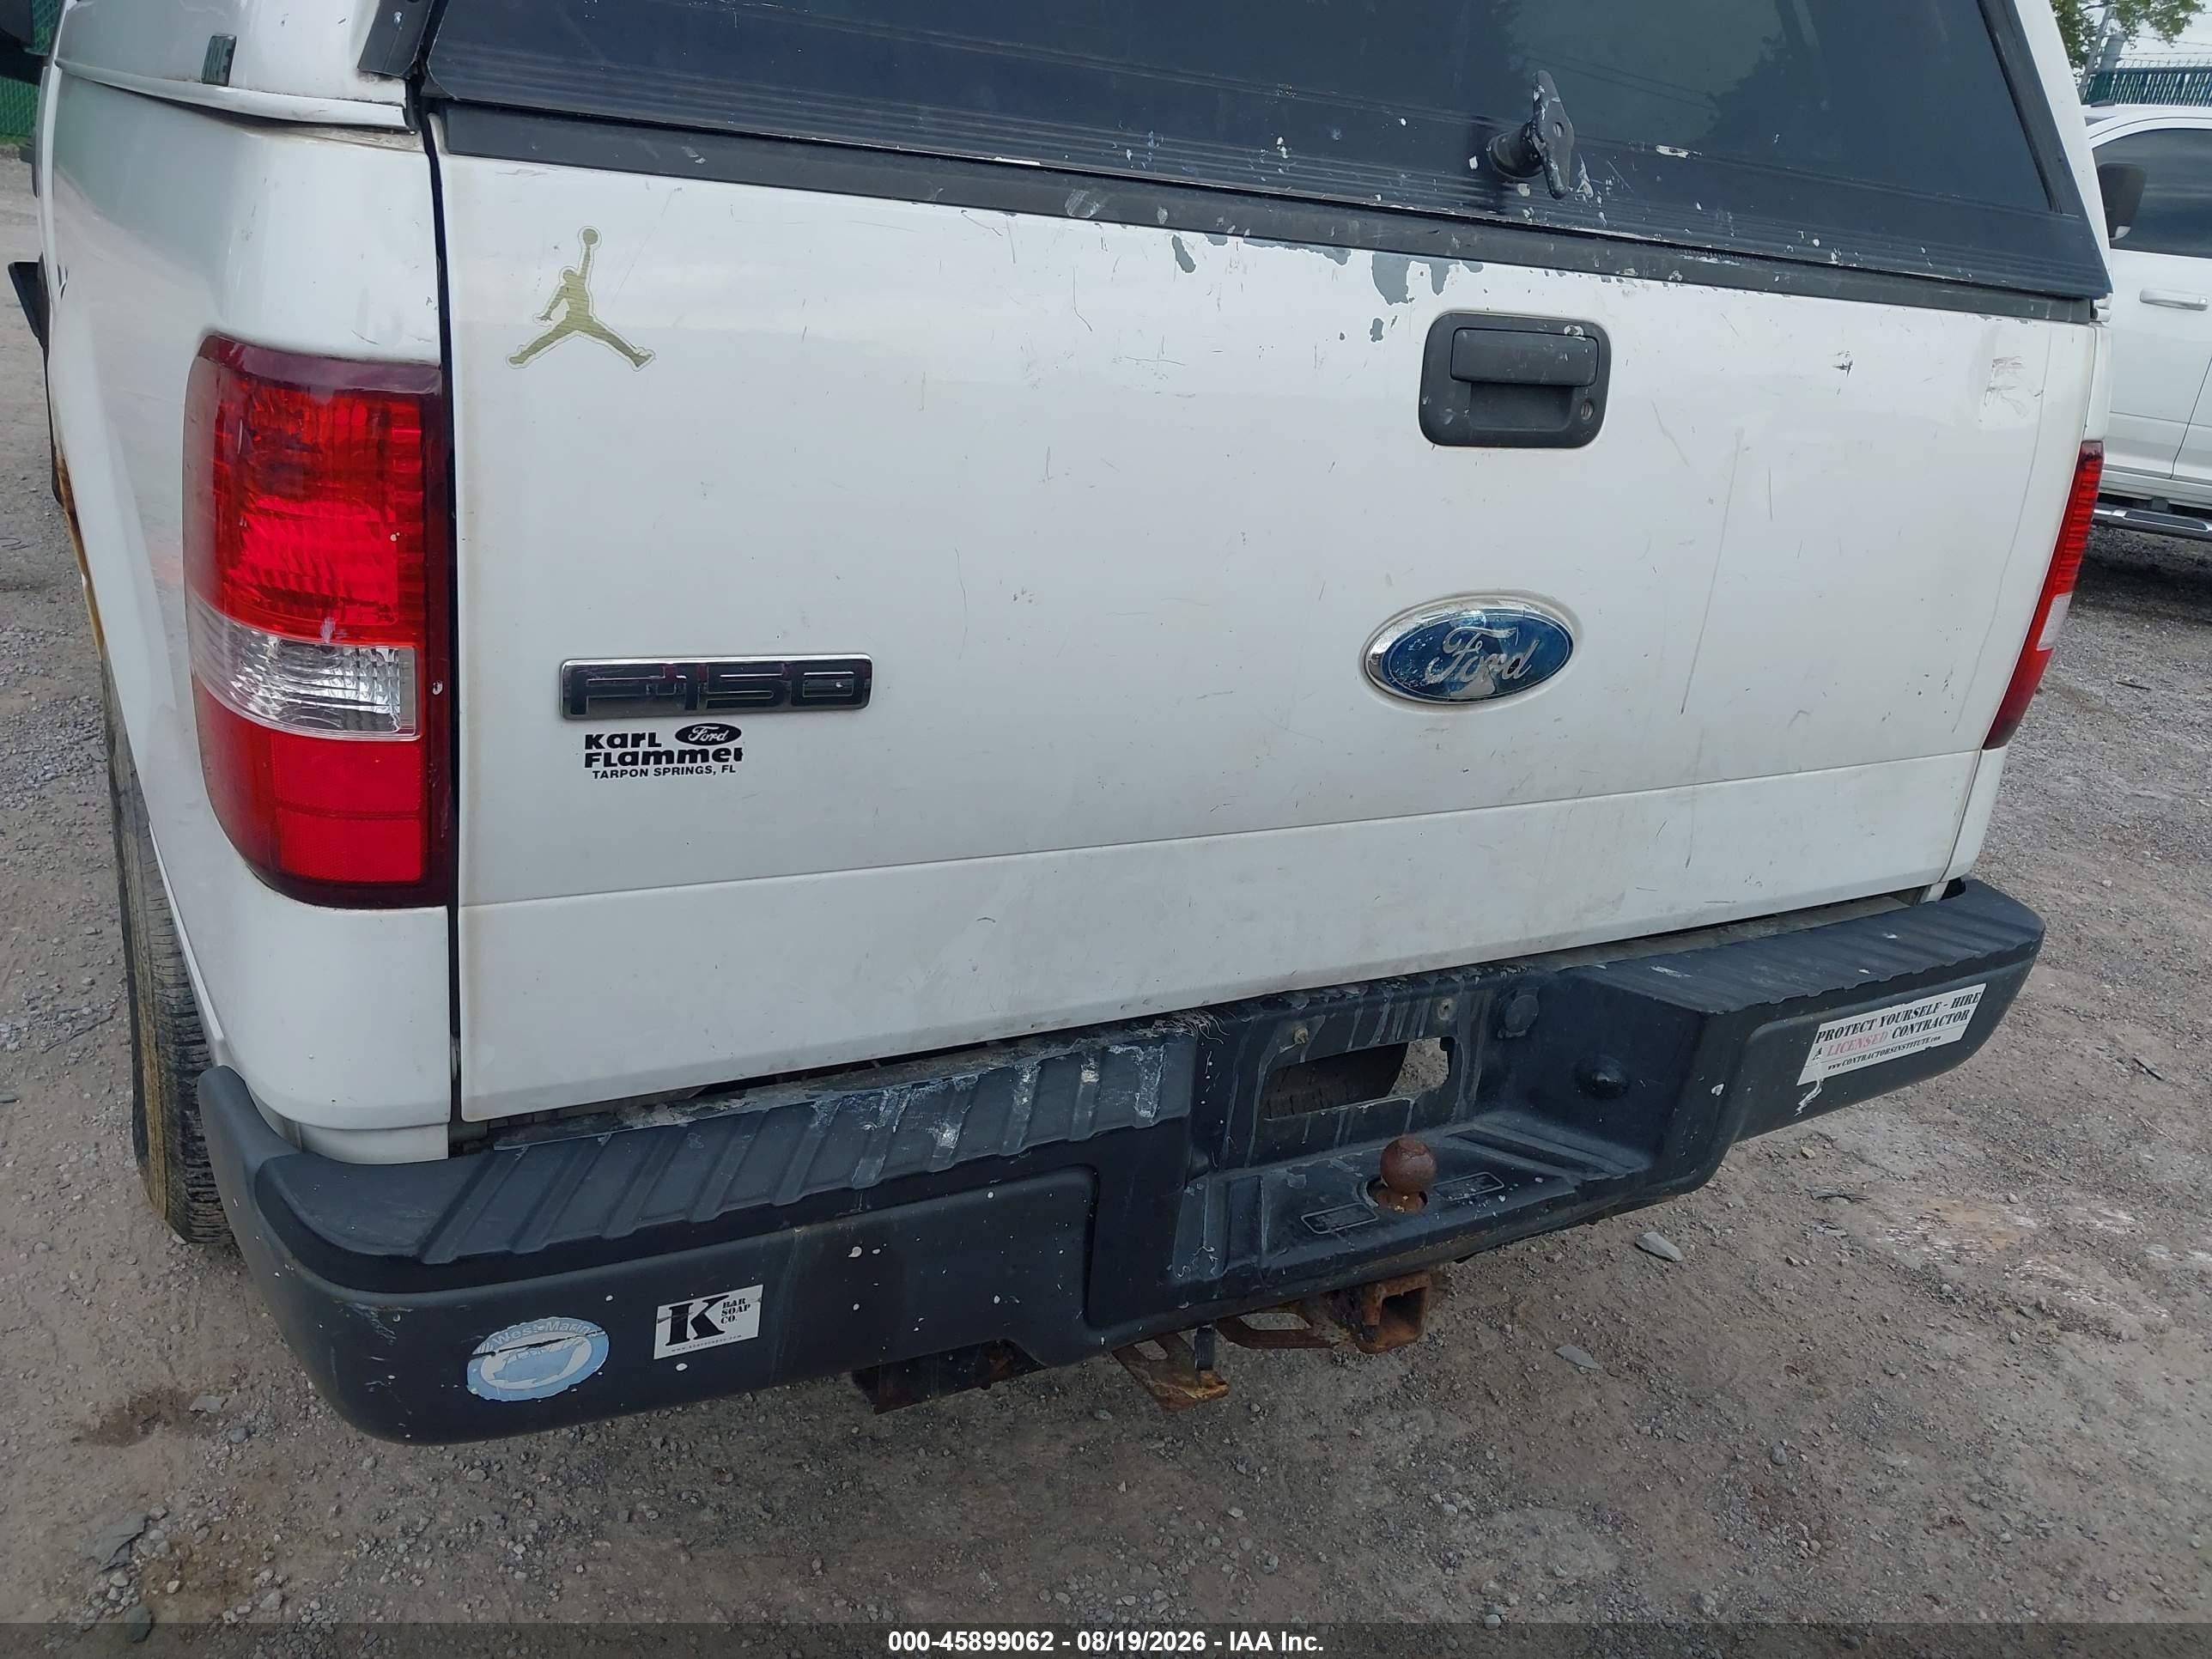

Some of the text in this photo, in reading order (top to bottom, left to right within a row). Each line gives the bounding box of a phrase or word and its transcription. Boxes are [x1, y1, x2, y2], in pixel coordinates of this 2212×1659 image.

[1425, 626, 1541, 684] Ford
[688, 726, 730, 743] Ford
[592, 764, 737, 780] TARPON SPRINGS, FL
[1814, 1018, 1878, 1044] PROTECT
[1879, 1001, 1942, 1028] YOURSELF
[1949, 992, 1982, 1010] HIRE
[1826, 1030, 1889, 1057] LICENSED
[1892, 1009, 1971, 1040] CONTRACTOR
[721, 1304, 751, 1317] SOAP
[722, 1297, 746, 1310] BAR
[665, 1294, 730, 1346] K
[720, 1316, 738, 1325] CO.
[492, 1323, 539, 1346] West
